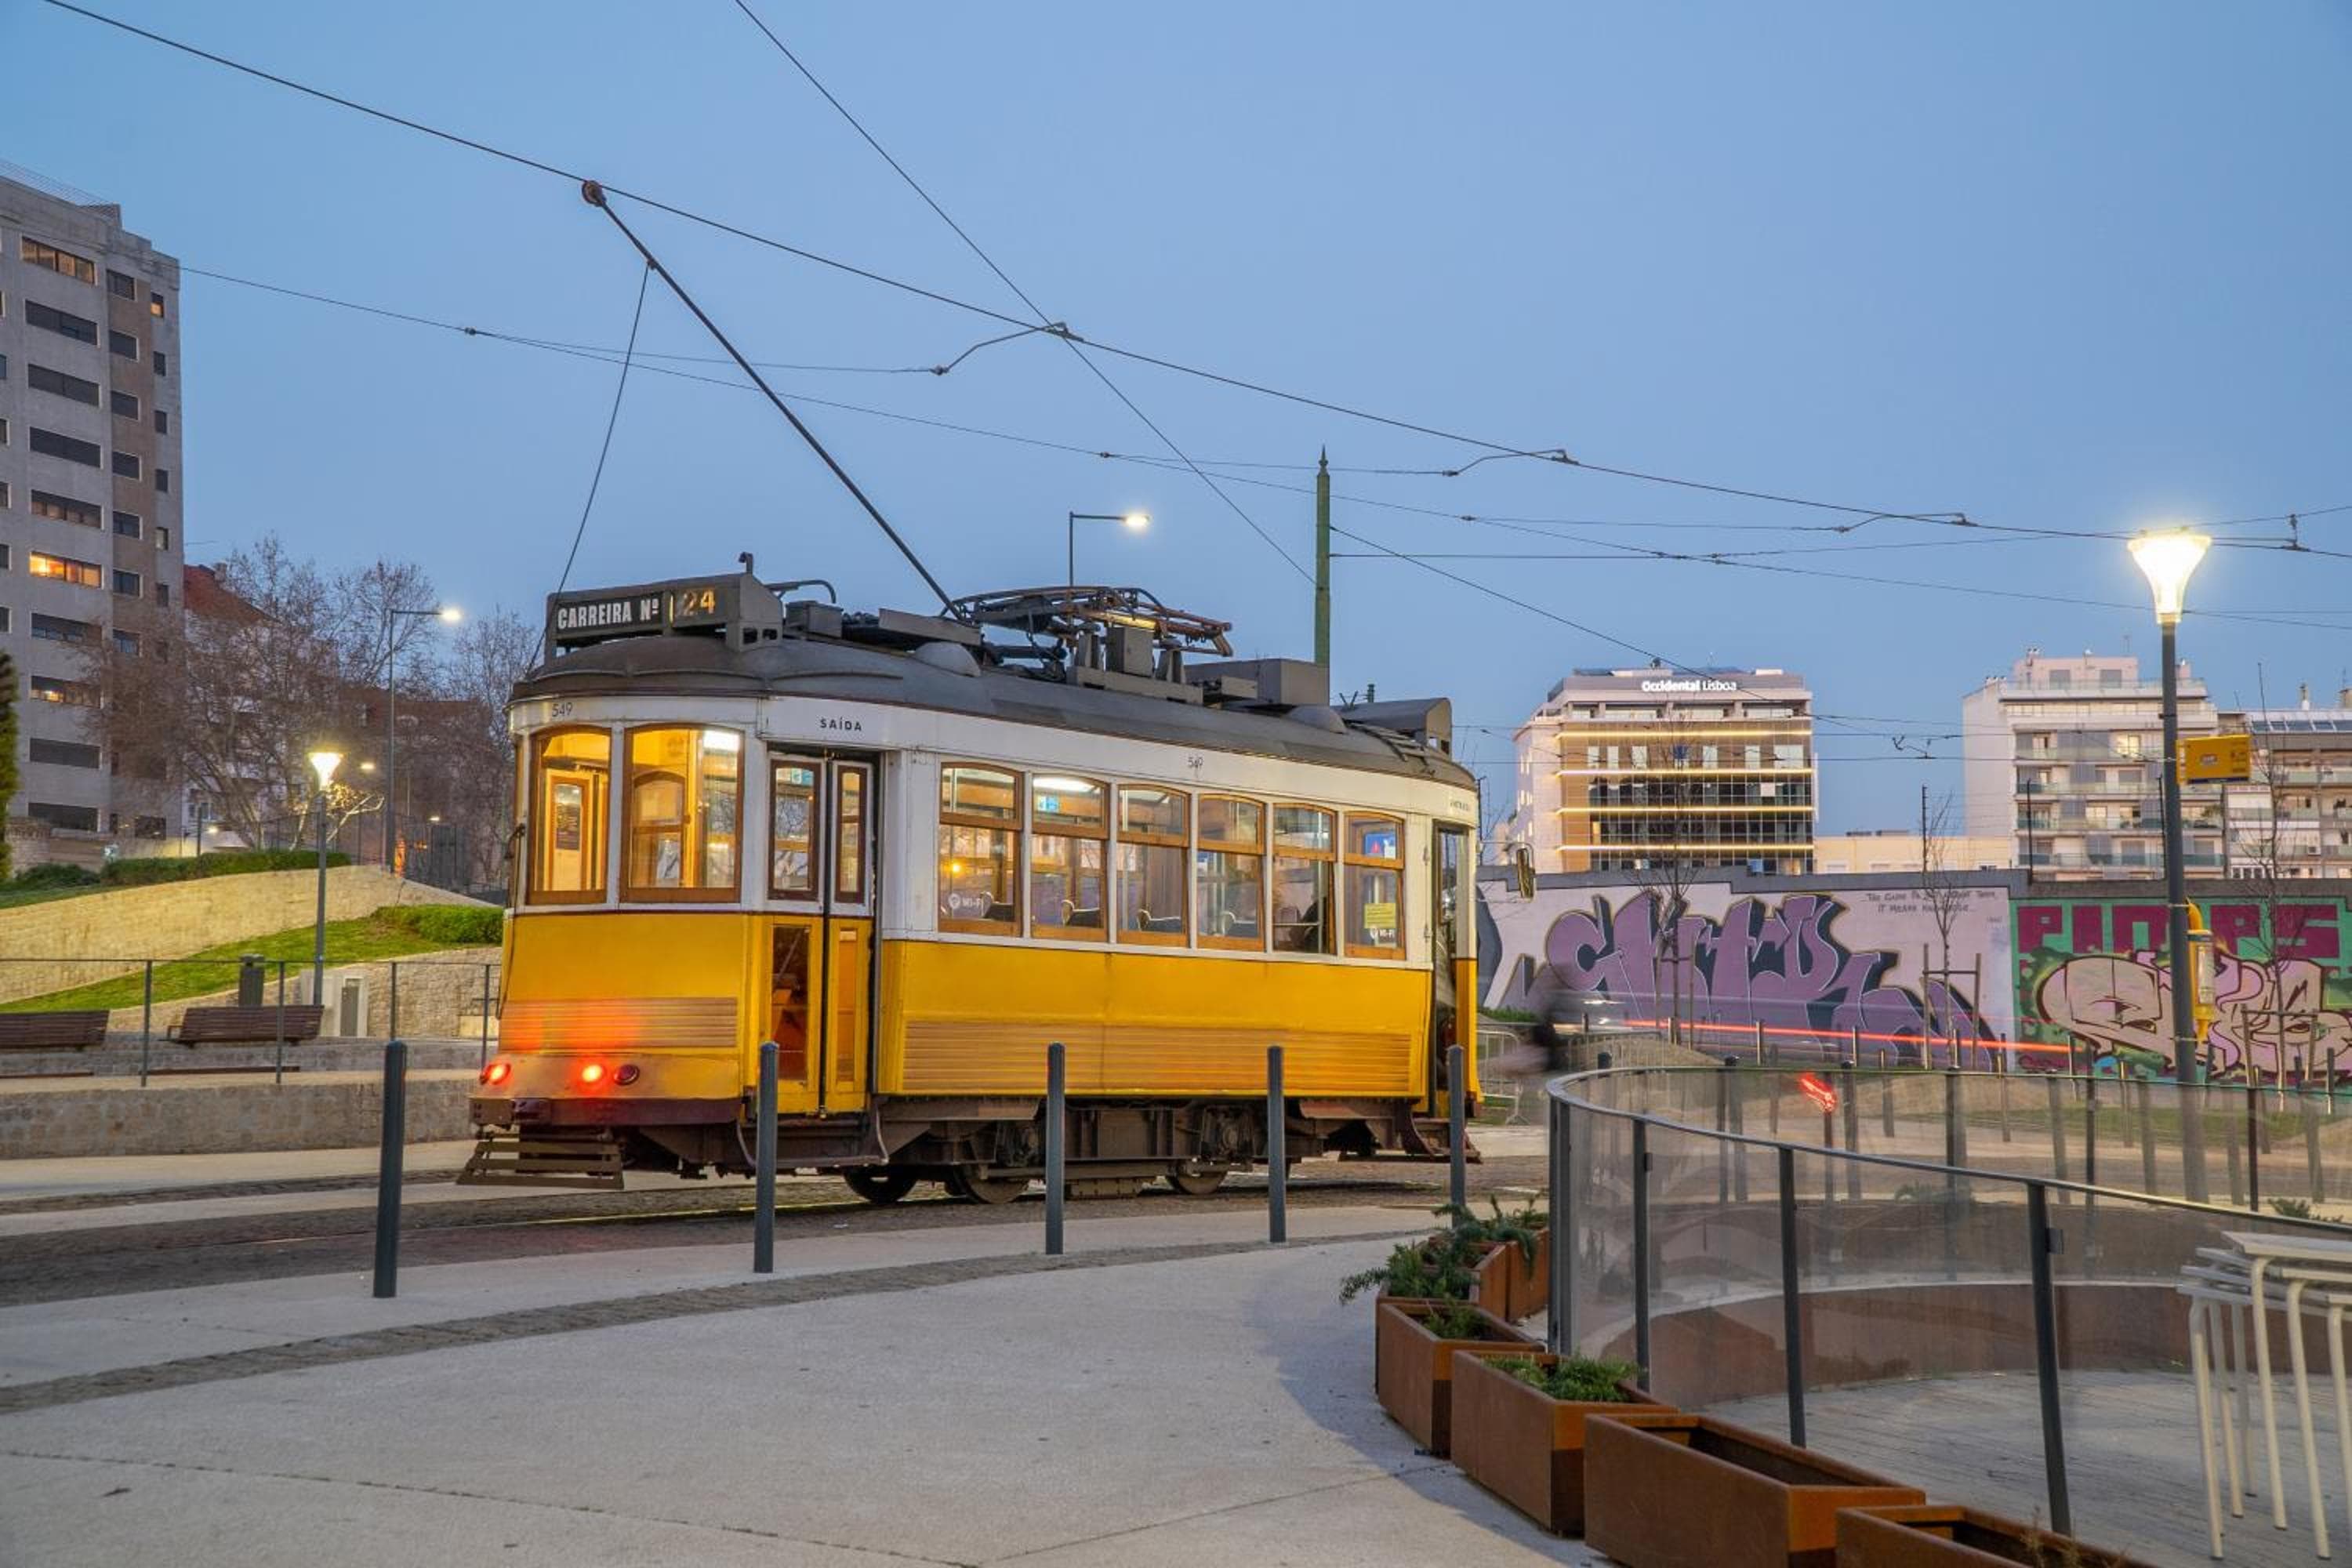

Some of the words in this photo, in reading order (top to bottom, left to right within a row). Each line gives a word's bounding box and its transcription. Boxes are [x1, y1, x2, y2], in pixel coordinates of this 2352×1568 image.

[557, 601, 632, 629] CARREIRA
[682, 590, 715, 616] 24
[1642, 680, 1700, 691] Occidental
[1702, 680, 1737, 691] Lisboa
[552, 702, 573, 717] 549
[819, 716, 862, 731] SAÍDA
